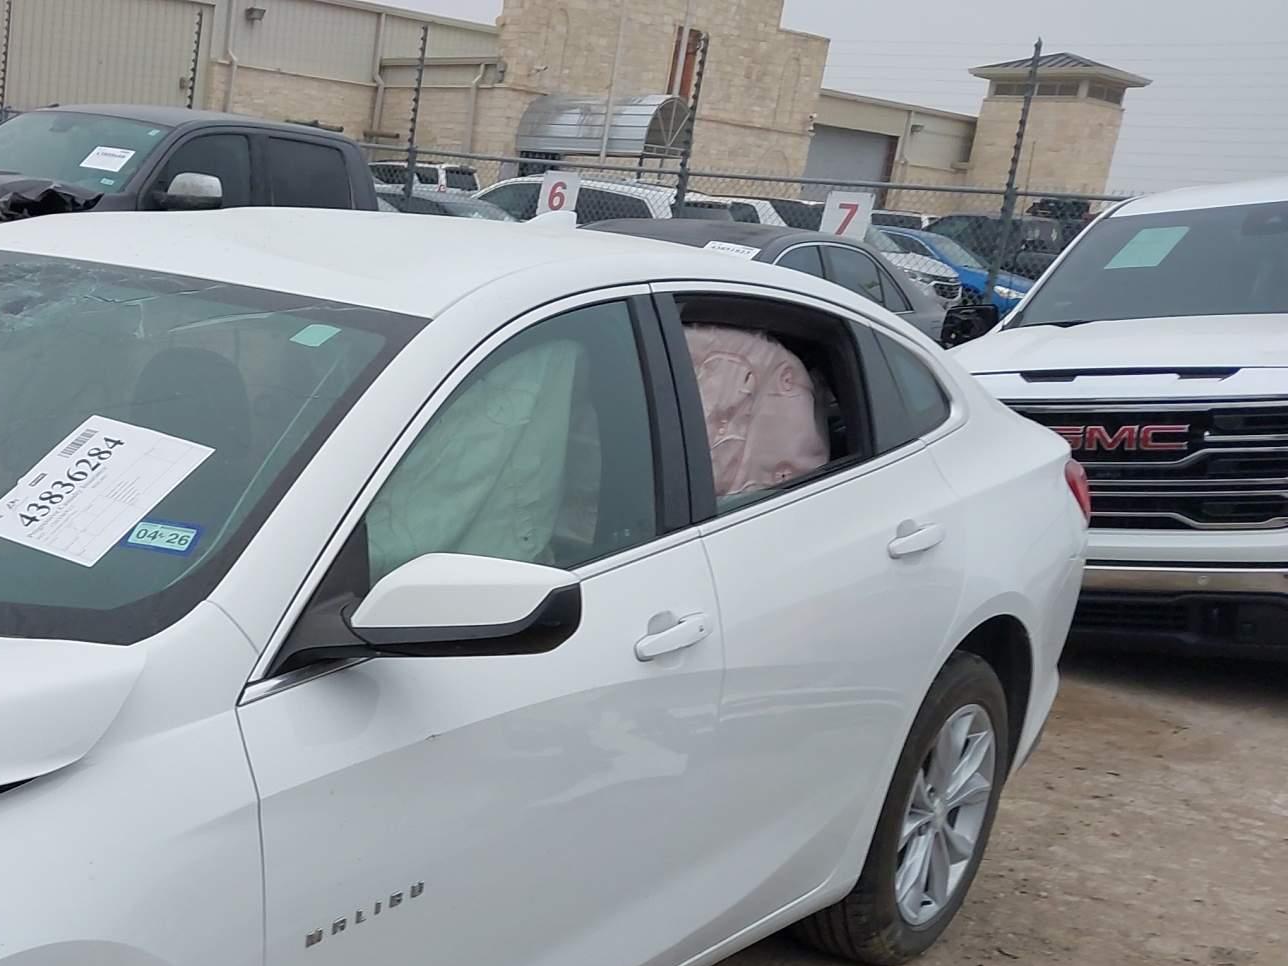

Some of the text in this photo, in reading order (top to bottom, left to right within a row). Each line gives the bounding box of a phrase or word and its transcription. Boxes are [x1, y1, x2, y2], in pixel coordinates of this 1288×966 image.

[547, 181, 568, 211] 6
[835, 203, 859, 235] 7
[17, 436, 125, 527] 43836284
[136, 528, 191, 546] 04 26
[305, 881, 424, 948] MALIBU
